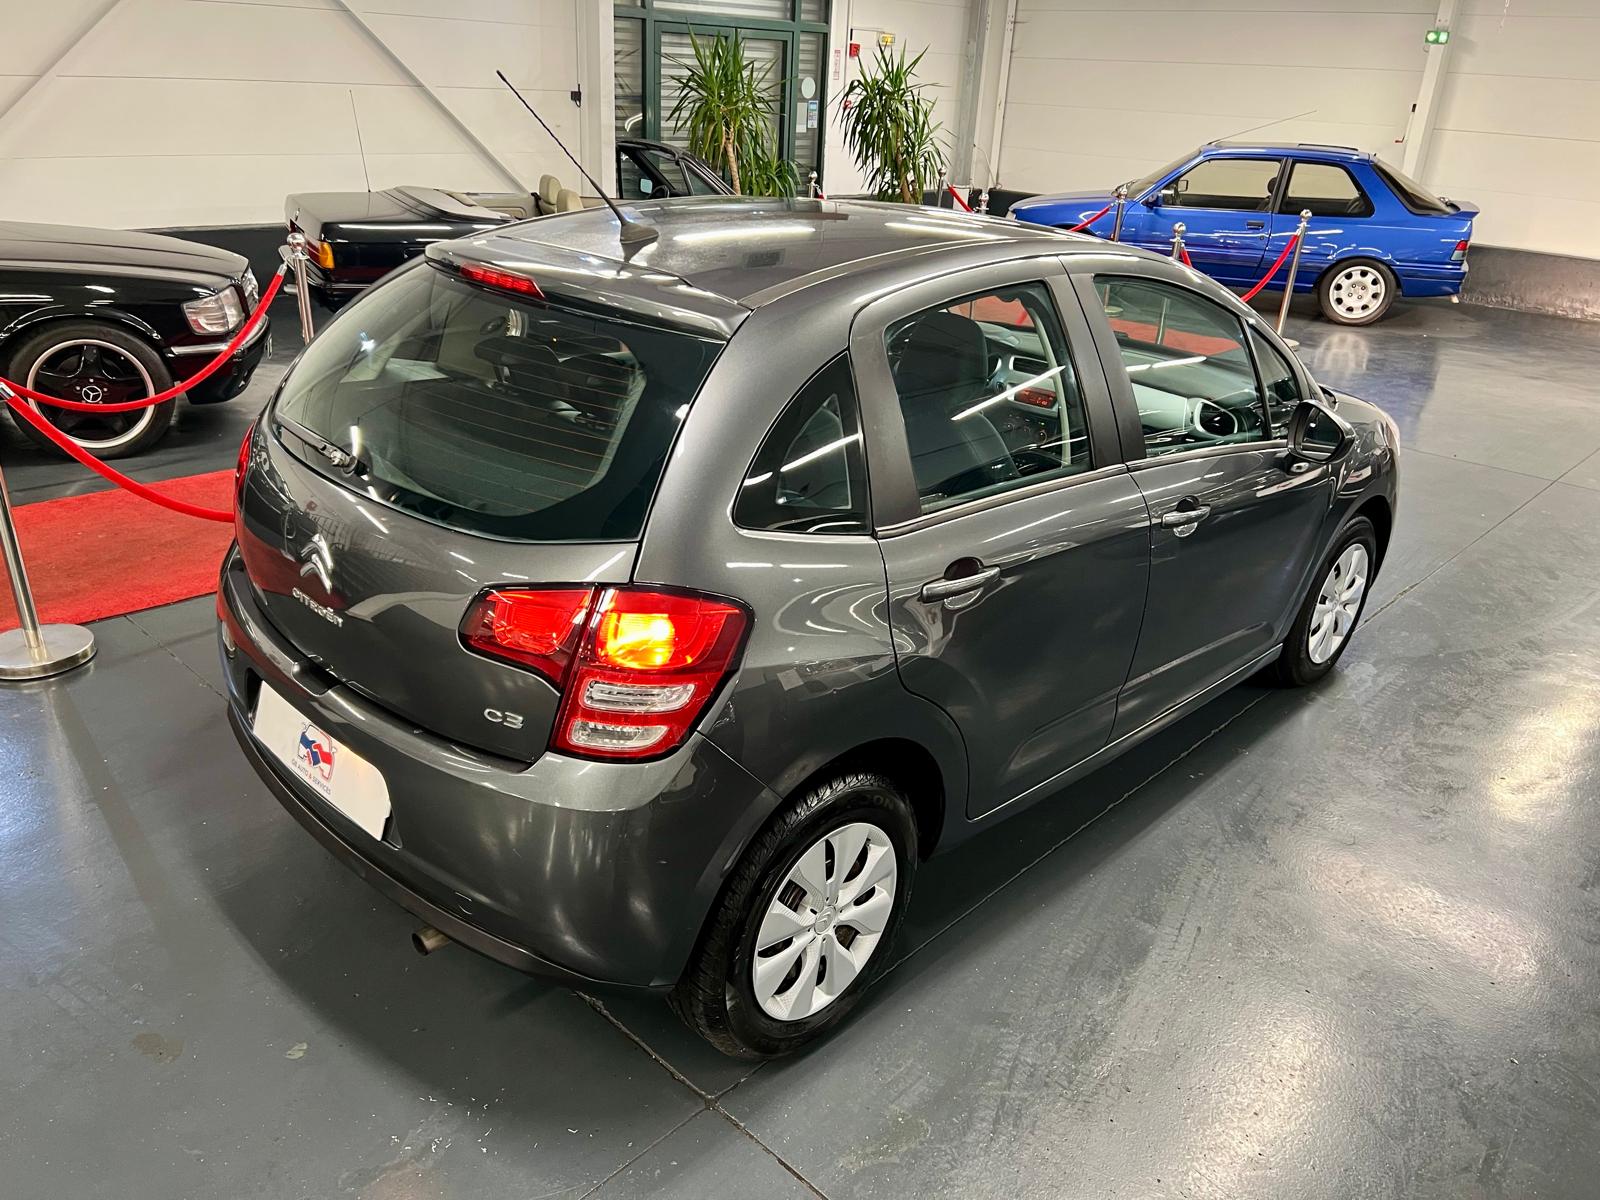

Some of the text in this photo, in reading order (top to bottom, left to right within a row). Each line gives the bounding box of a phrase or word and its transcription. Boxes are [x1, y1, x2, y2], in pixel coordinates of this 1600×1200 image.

[484, 708, 523, 729] C3
[298, 763, 309, 777] AUTO
[312, 776, 332, 796] SERVICES
